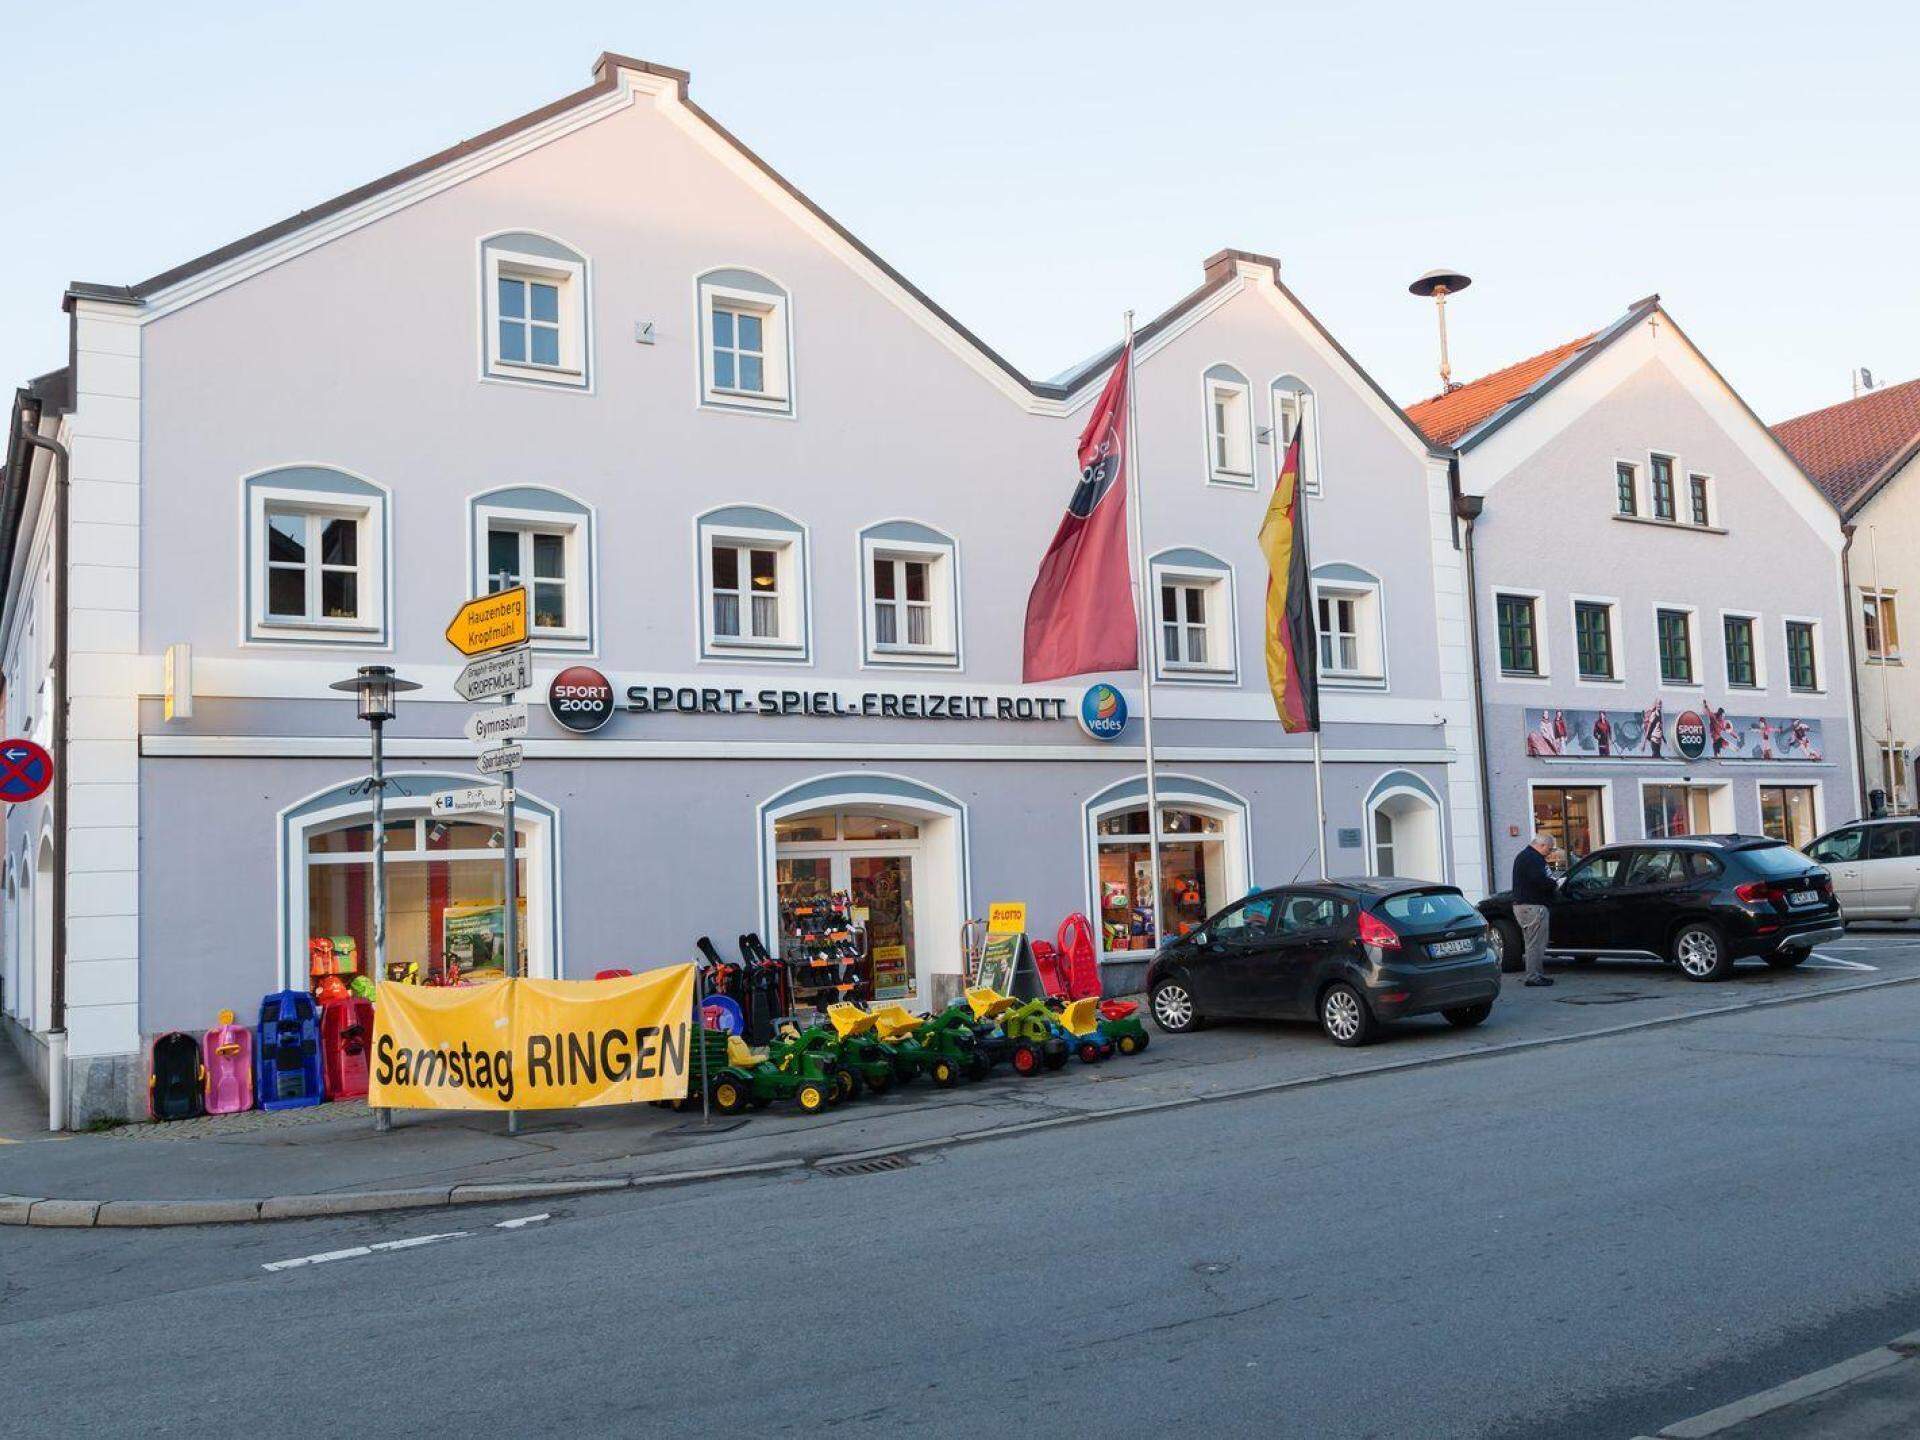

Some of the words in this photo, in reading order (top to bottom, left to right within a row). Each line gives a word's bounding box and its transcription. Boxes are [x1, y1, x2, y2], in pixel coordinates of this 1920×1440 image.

[468, 601, 521, 625] Hauzenberg
[468, 622, 516, 646] Kropfmühl
[468, 673, 515, 696] KROPFMÜHL
[555, 686, 607, 697] SPORT
[559, 700, 604, 712] 2000
[996, 696, 1066, 720] ROTT
[476, 715, 525, 738] Gymnasium
[1088, 717, 1122, 730] vedes
[1679, 725, 1702, 734] SPORT
[1681, 735, 1702, 744] 2000
[376, 1034, 514, 1102] Samstag
[527, 1022, 686, 1087] RINGEN
